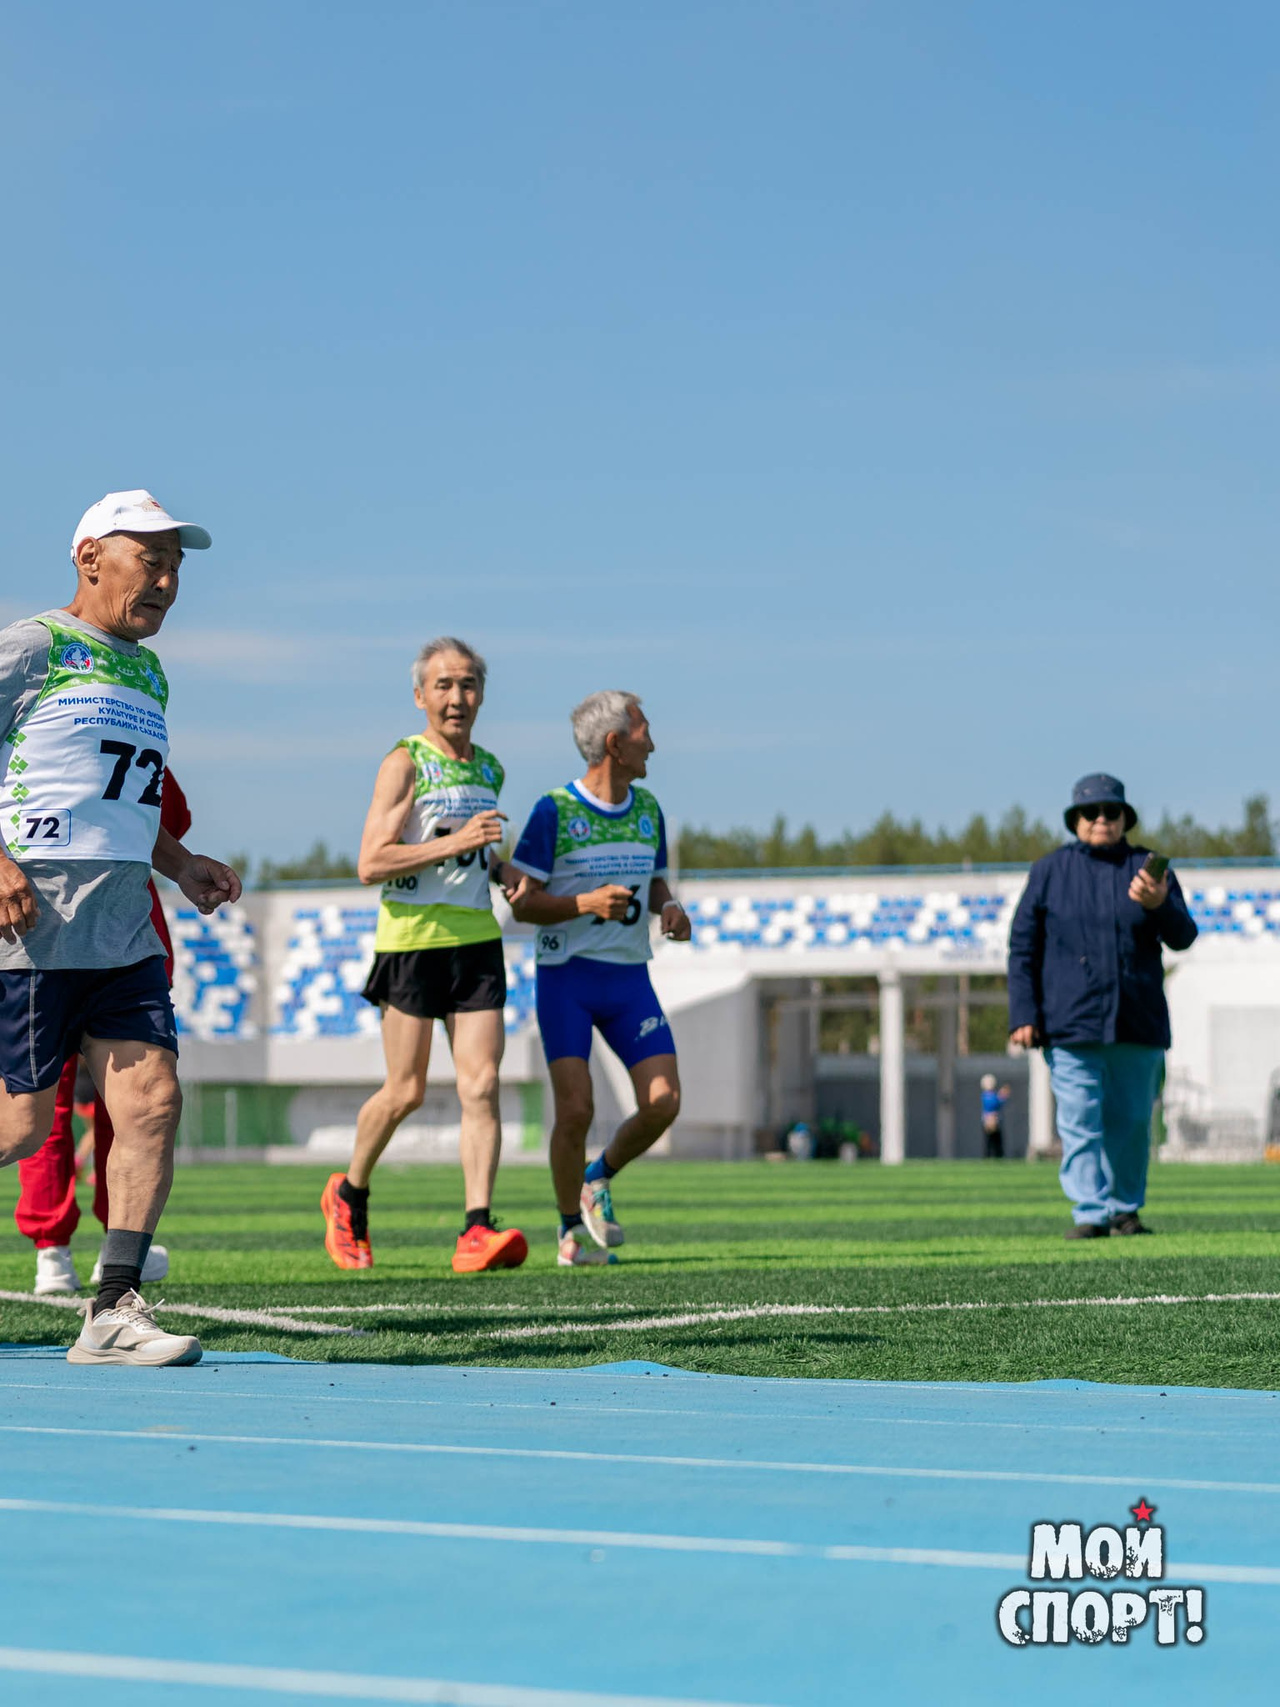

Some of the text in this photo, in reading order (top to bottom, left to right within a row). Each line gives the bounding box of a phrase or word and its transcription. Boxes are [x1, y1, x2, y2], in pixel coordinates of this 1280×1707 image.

[58, 696, 135, 712] МИНИСТЕРСТВО
[98, 707, 138, 722] КУЛЬТУРЕ
[74, 717, 138, 731] РЕСПУБЛИКИ
[100, 739, 163, 808] 72
[26, 816, 60, 838] 72
[542, 935, 559, 951] 96
